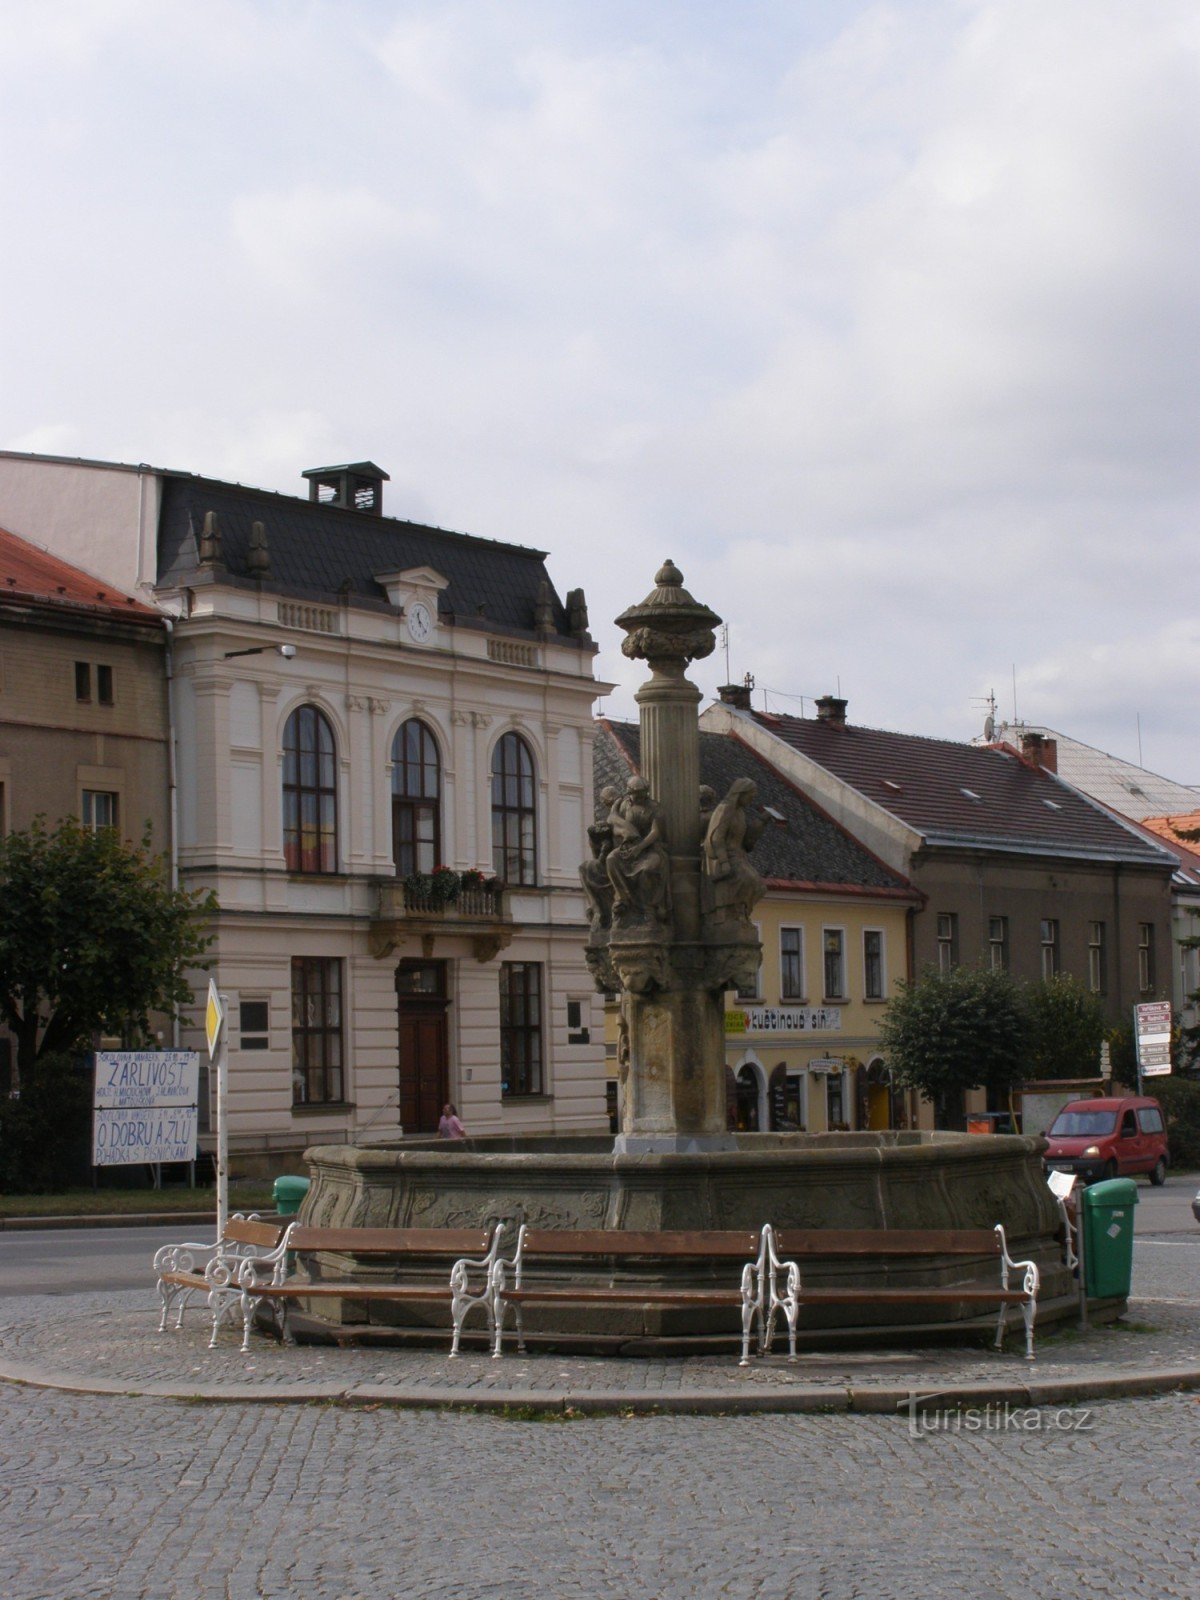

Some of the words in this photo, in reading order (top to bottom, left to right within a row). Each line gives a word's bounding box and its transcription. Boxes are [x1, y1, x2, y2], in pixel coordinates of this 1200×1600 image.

[97, 1122, 107, 1148] O
[110, 1121, 153, 1148] DOBRU
[155, 1121, 163, 1145] A
[165, 1120, 191, 1145] ZLU
